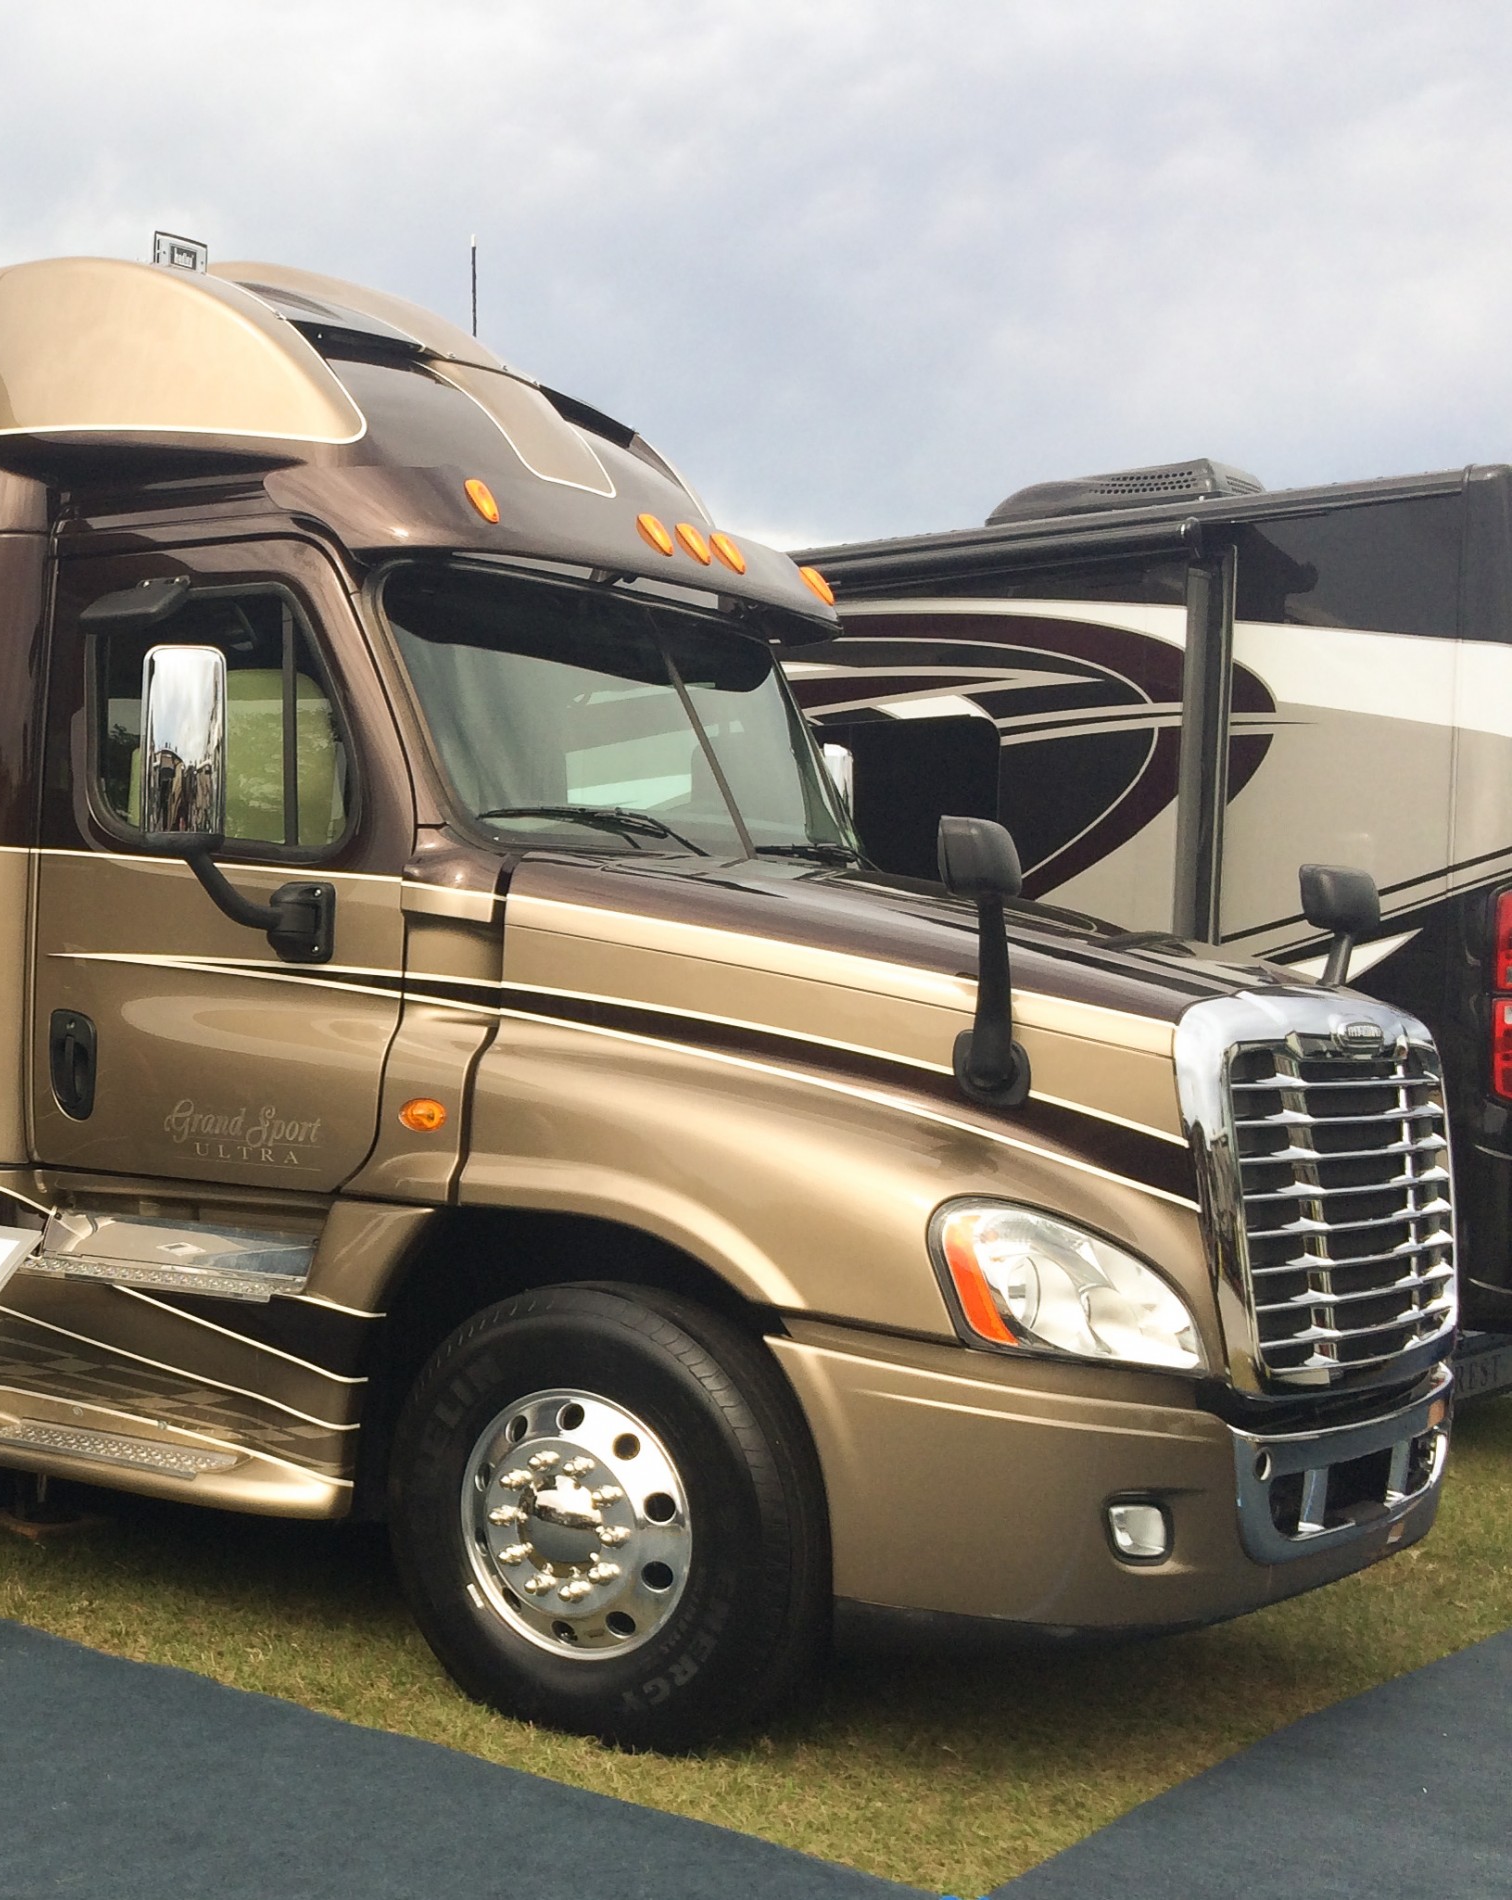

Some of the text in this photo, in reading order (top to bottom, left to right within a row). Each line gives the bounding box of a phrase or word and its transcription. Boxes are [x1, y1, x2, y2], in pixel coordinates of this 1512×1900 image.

[164, 1098, 321, 1148] Grand Sport
[194, 1142, 299, 1164] ULTRA
